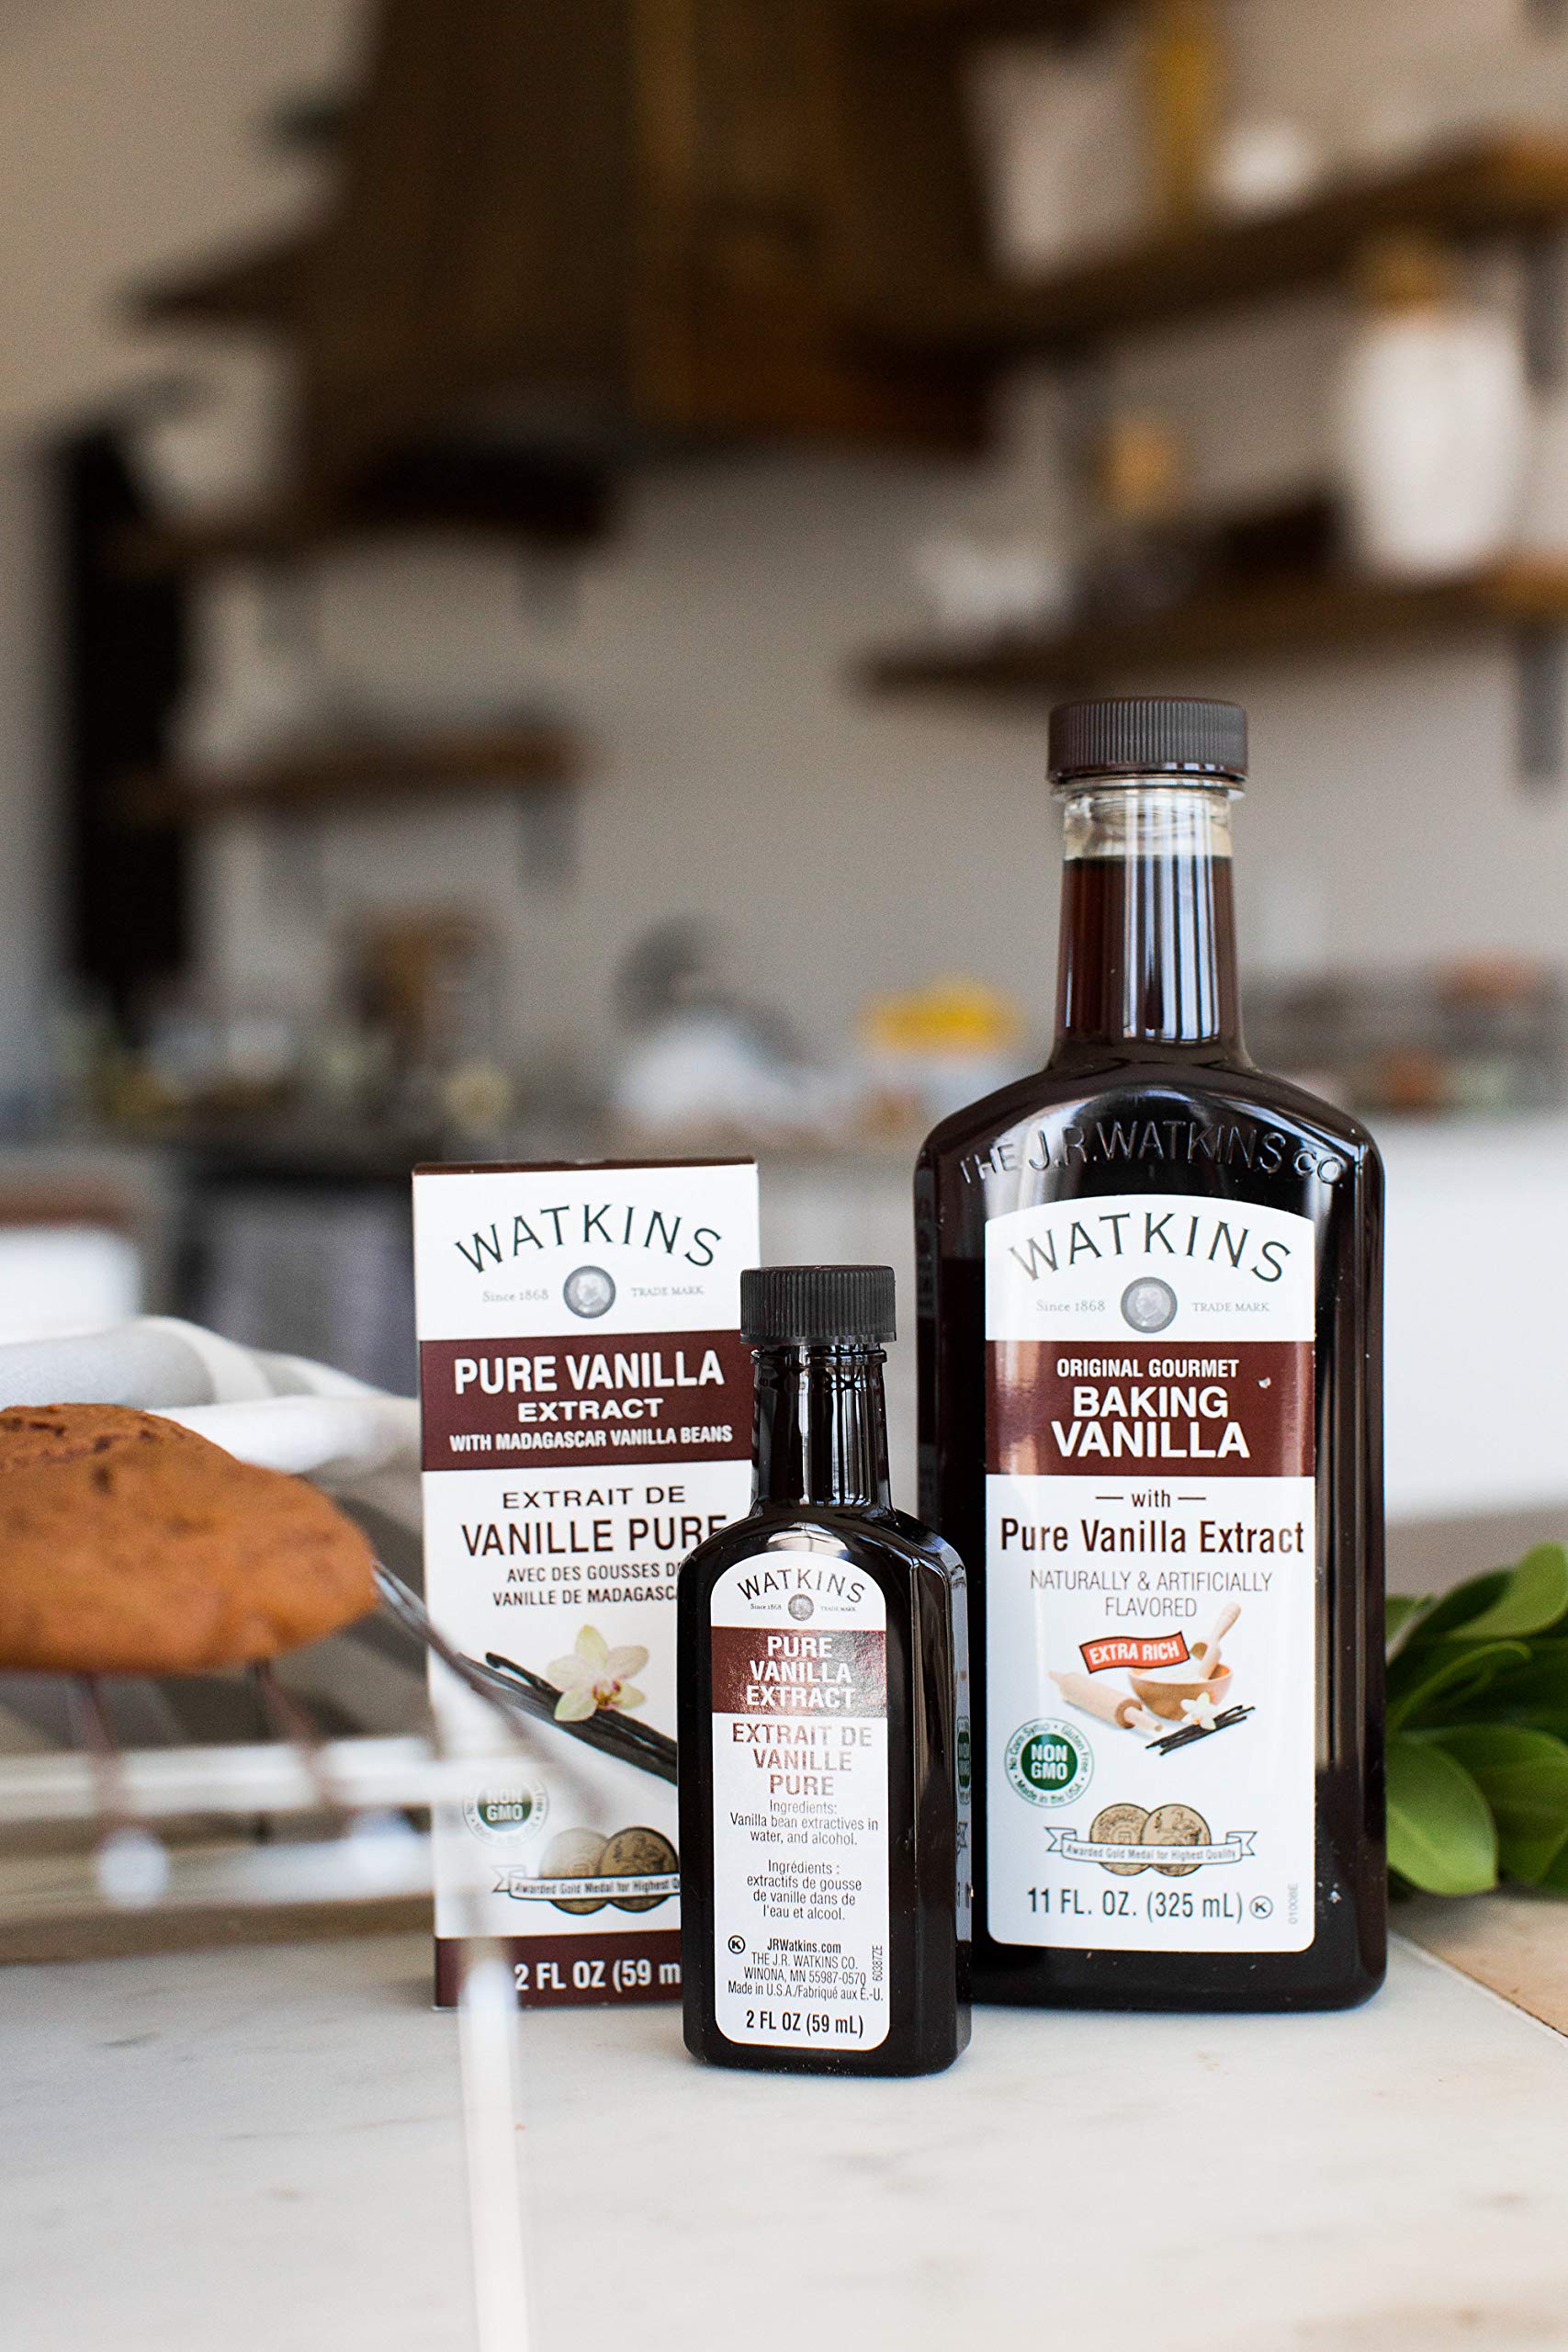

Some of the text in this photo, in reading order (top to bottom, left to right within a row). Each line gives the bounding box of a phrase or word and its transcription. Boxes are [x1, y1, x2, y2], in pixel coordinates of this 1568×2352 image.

[455, 1204, 722, 1273] WATKINS
[1009, 1212, 1292, 1283] WATKINS
[482, 1289, 548, 1302] Since 1868
[631, 1285, 705, 1298] TRADE MARK
[1036, 1299, 1106, 1313] Since 1868
[1191, 1302, 1269, 1313] TRADE MARK
[455, 1350, 725, 1395] PURE VANILLA
[1056, 1358, 1239, 1378] ORIGINAL GOURMET
[518, 1398, 663, 1423] EXTRACT
[1073, 1385, 1229, 1419] BAKING
[450, 1425, 732, 1452] WITH MADAGASCAR VANILLA BEANS
[1051, 1421, 1250, 1458] VANILLA
[503, 1486, 685, 1509] EXTRAIT DE
[1132, 1489, 1171, 1508] with
[462, 1521, 613, 1556] VANILLE
[1000, 1518, 1303, 1554] Pure Vanilla Extract
[507, 1563, 681, 1583] AVEC DES GOUSSES D
[1030, 1570, 1272, 1592] NATURALLY & ARTIFICIALLY
[737, 1568, 866, 1603] WATKINS
[493, 1585, 678, 1607] VANILLE DE MADAGASC
[1105, 1597, 1197, 1617] FLAVORED
[767, 1636, 832, 1657] PURE
[1089, 1641, 1179, 1664] EXTRA RICH
[750, 1660, 852, 1683] VANILLA
[746, 1685, 855, 1708] EXTRACT
[732, 1723, 872, 1747] EXTRAIT DE
[752, 1748, 852, 1770] VANILLE
[1031, 1744, 1067, 1762] NON
[1031, 1761, 1067, 1781] GMO
[770, 1774, 834, 1796] PURE
[487, 1804, 523, 1822] GMO
[770, 1799, 837, 1815] Ingredients:
[730, 1812, 878, 1830] Vanilla bean extractives in
[750, 1830, 858, 1846] water, and alcohol.
[1066, 1844, 1102, 1858] Awarded
[1105, 1849, 1125, 1859] Gold
[1128, 1849, 1153, 1860] Medal
[1171, 1850, 1203, 1861] Highest
[768, 1860, 832, 1875] Ingrédients
[747, 1874, 863, 1891] extractifs de gousse
[753, 1890, 856, 1905] de vanille dans de
[1027, 1887, 1050, 1914] 11
[1060, 1888, 1092, 1916] FL.
[1102, 1890, 1137, 1917] OZ.
[1146, 1891, 1193, 1924] (325
[1202, 1892, 1243, 1925] mL)
[763, 1904, 846, 1920] l'eau et alcool.
[767, 1939, 841, 1953] JRWatkins.com
[751, 1952, 858, 1970] THE J.R. WATKINS CO.
[513, 1962, 530, 1991] 2
[536, 1962, 567, 1990] FL
[572, 1960, 606, 1988] OZ
[612, 1959, 652, 1993] (59
[744, 1967, 866, 1985] WINONA, MN 55987-0570
[728, 1981, 752, 1995] Made
[756, 1983, 763, 1995] in
[766, 1984, 838, 2001] U.S.A./Fabriqué
[840, 1989, 857, 2000] aux
[746, 2010, 864, 2039] 2 FL OZ (59 mL)
